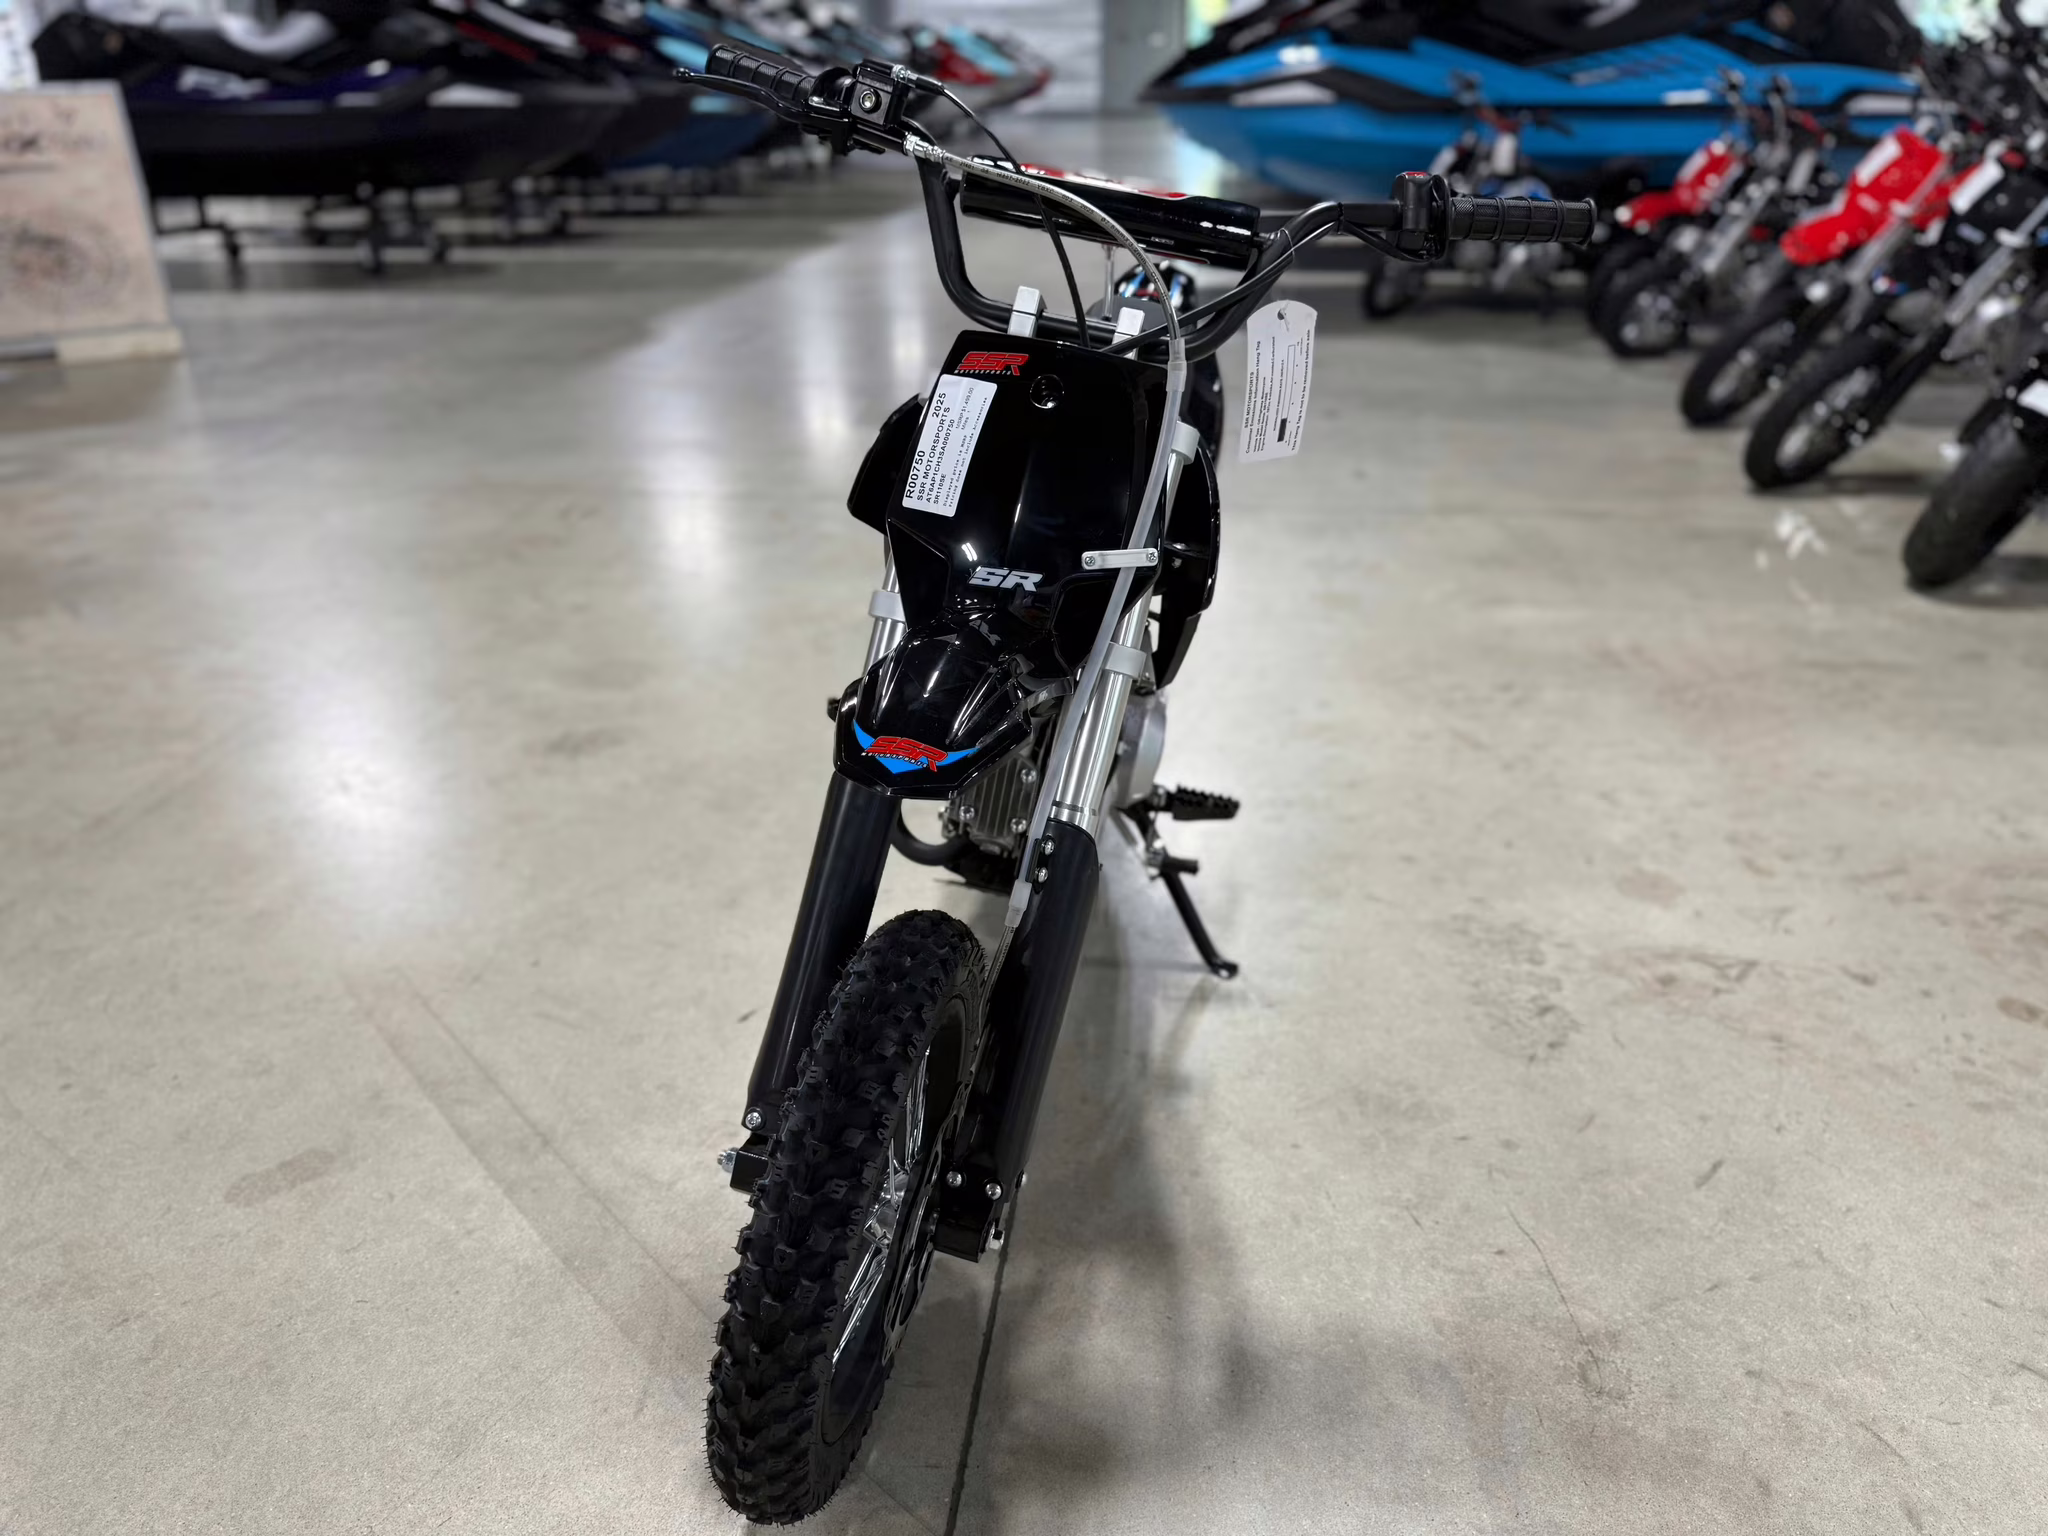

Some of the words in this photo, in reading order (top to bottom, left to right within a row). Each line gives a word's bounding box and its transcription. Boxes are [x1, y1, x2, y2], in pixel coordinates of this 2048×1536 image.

[957, 351, 1028, 376] SSR
[1246, 372, 1254, 416] MOTORSPORTS
[906, 450, 926, 499] R00750
[932, 392, 946, 419] 2025
[918, 482, 927, 501] SSR
[923, 407, 951, 480] MOTORSPORTS
[934, 474, 947, 505] SR110SE
[969, 566, 1044, 592] SR
[865, 736, 948, 772] SSR
